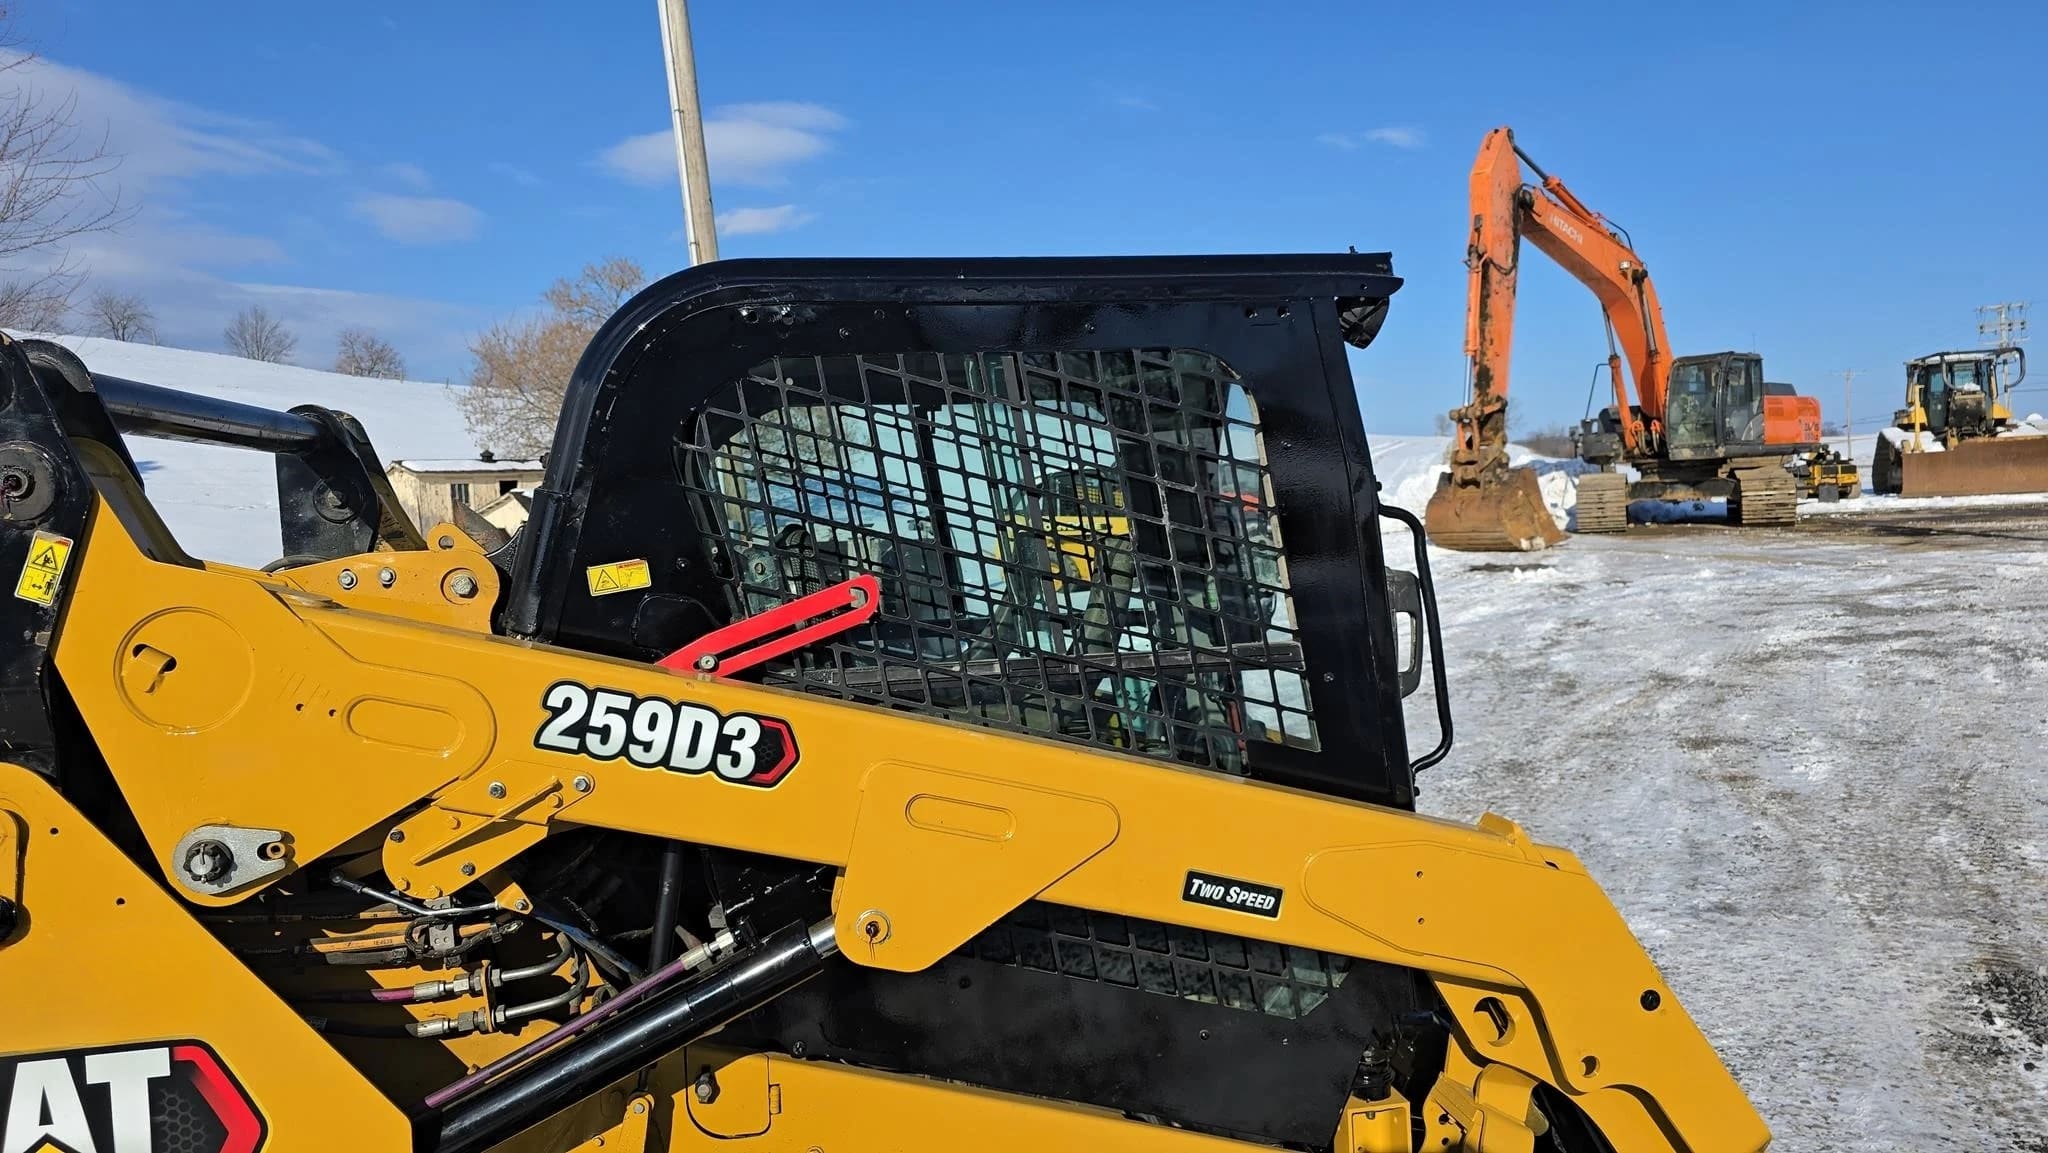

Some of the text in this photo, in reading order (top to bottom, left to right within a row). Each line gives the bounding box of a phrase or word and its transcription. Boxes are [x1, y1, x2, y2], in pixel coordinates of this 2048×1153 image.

[1549, 214, 1583, 245] HITACHI
[538, 684, 761, 779] 259D3
[2, 1047, 171, 1153] AT
